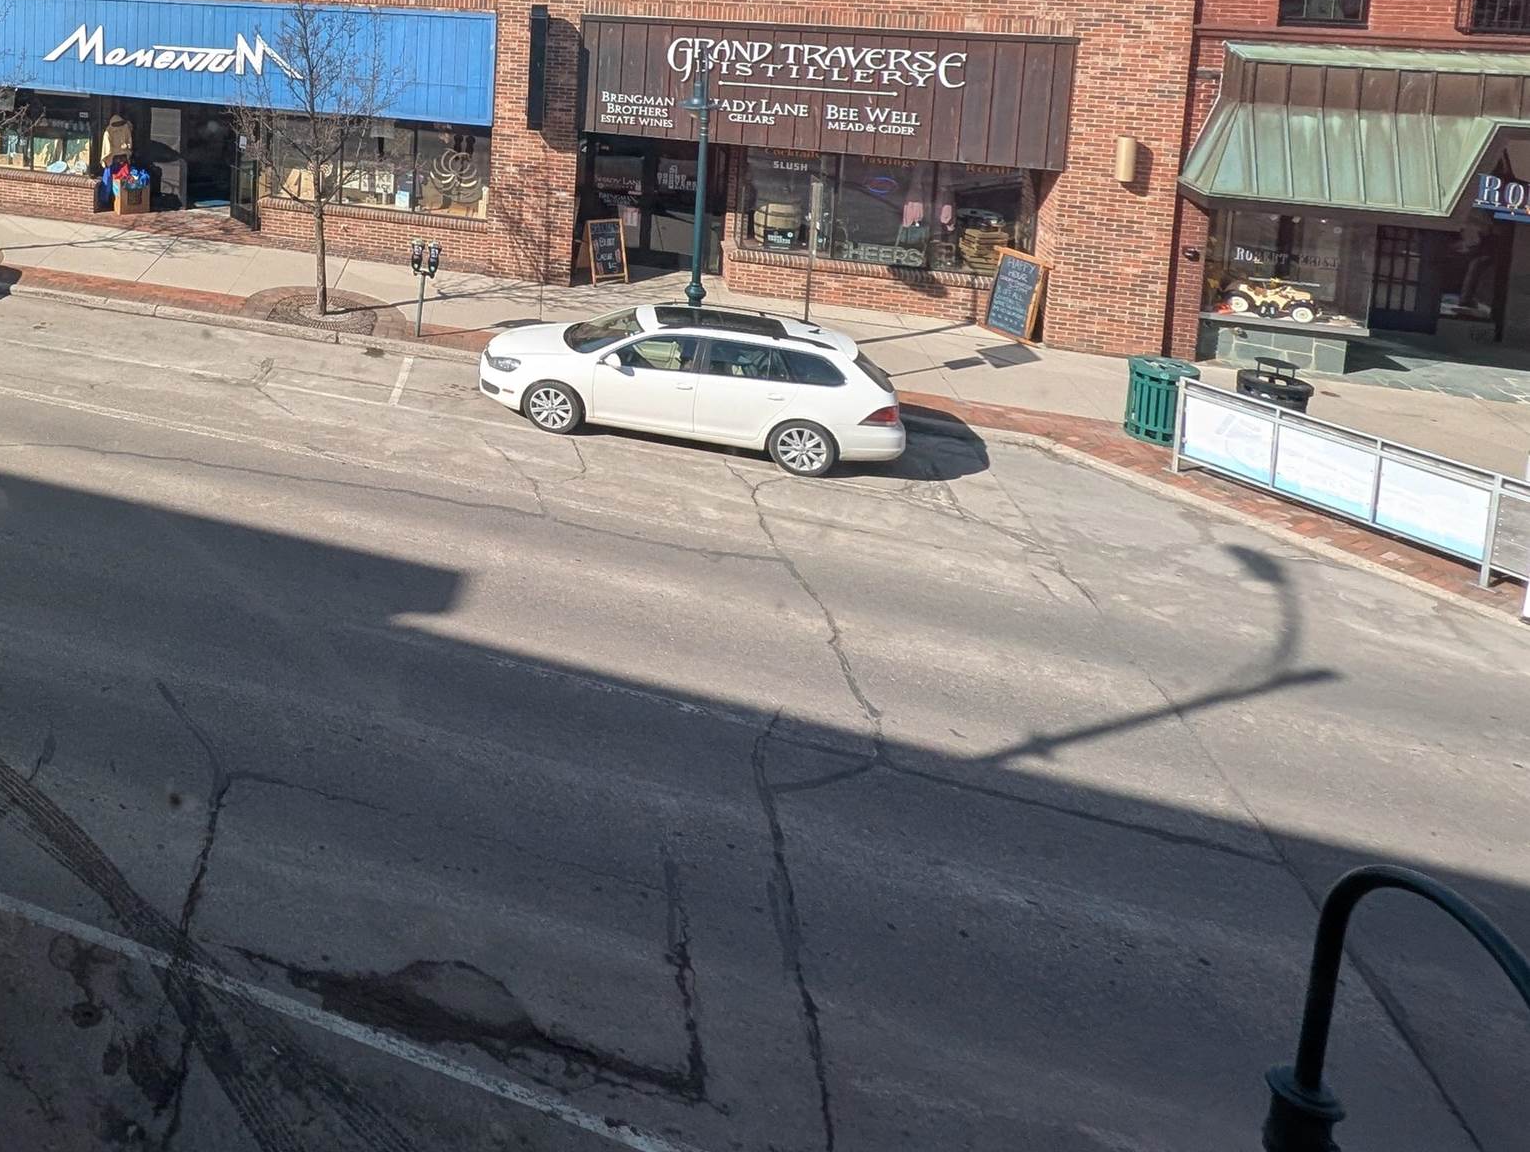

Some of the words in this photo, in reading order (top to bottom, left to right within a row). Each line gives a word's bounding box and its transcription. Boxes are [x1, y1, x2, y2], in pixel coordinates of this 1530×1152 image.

[667, 37, 773, 82] GRAND
[780, 43, 968, 89] TRAVERSE
[695, 60, 935, 87] DISTILLERY
[601, 91, 675, 107] BRENGMAN
[606, 103, 669, 118] BROTHERS
[760, 99, 809, 117] LANE
[826, 104, 859, 121] BEE
[865, 106, 921, 126] WELL
[600, 114, 636, 125] ESTATE
[638, 117, 674, 128] WINES
[728, 113, 776, 125] CELLARS
[827, 121, 865, 132] MEAD
[865, 123, 876, 133] &
[878, 124, 916, 136] CIDER
[773, 160, 808, 171] SLUSH
